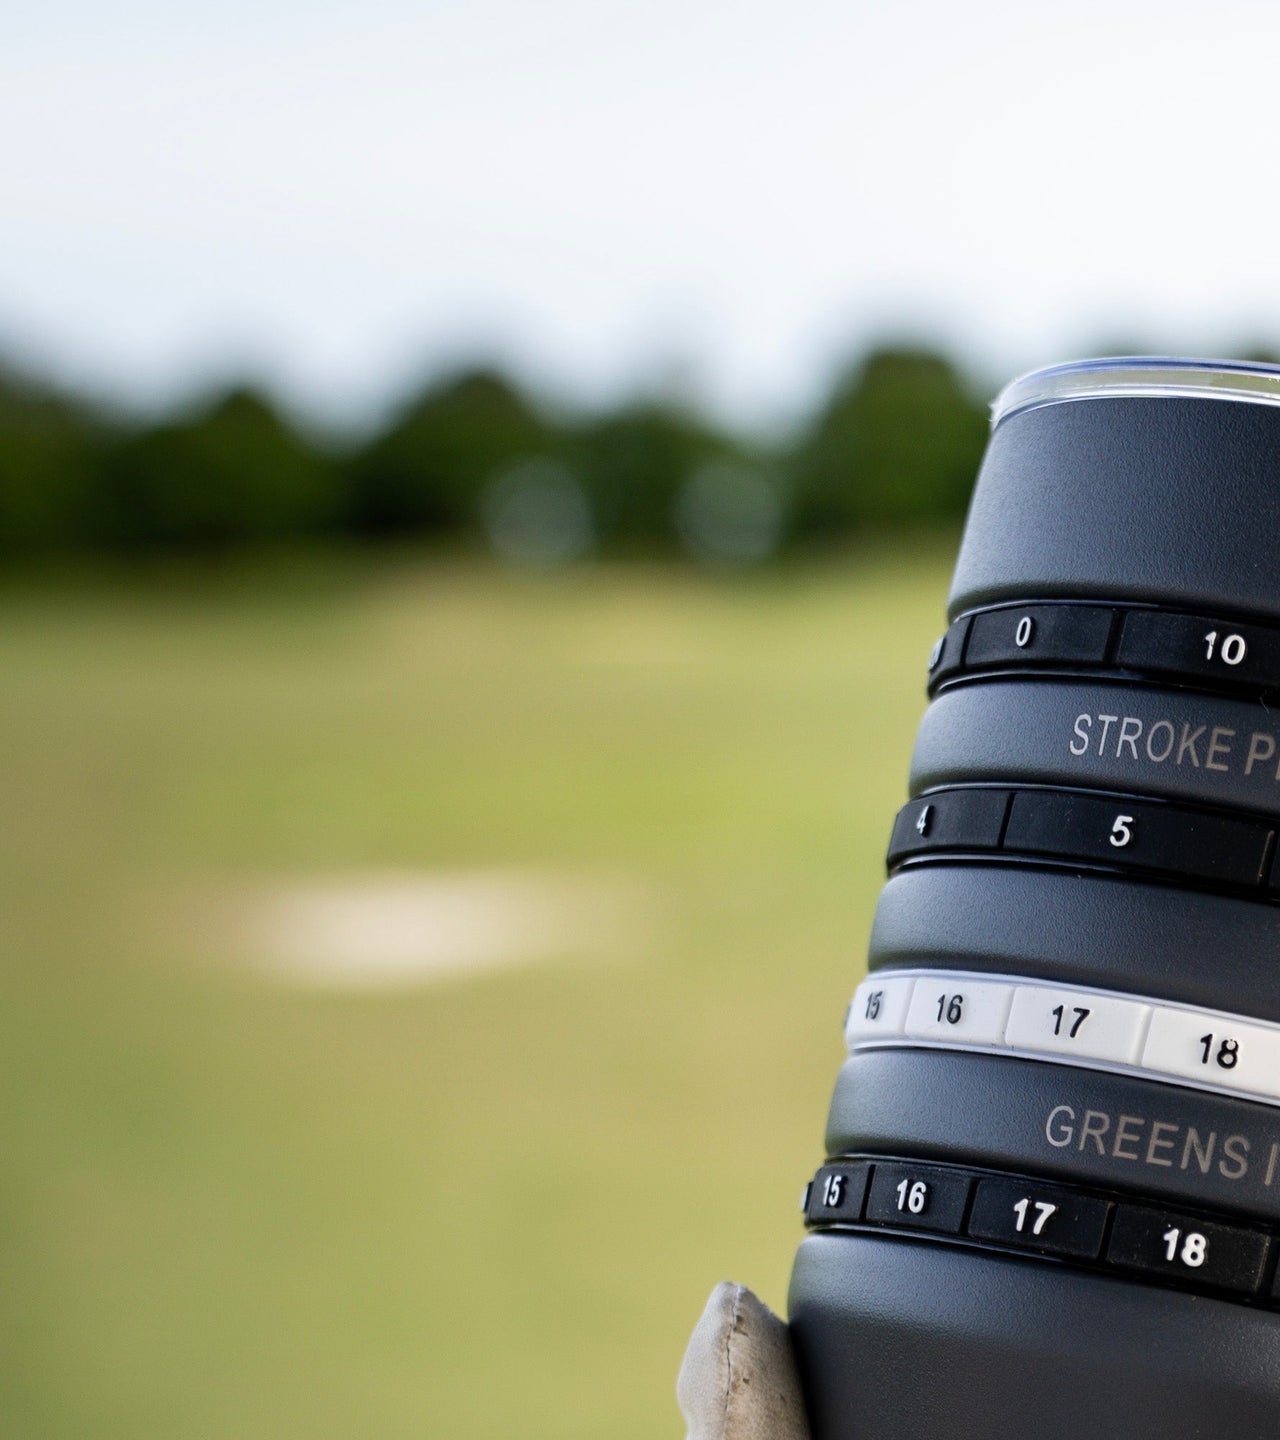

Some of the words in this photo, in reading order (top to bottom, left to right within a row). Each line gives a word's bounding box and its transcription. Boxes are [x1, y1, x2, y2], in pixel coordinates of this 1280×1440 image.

[1014, 616, 1033, 648] 0
[1204, 631, 1246, 665] 10
[1068, 713, 1237, 773] STROKE
[915, 804, 931, 835] 4
[1109, 815, 1134, 847] 5
[864, 992, 882, 1019] 15
[936, 994, 963, 1025] 16
[1051, 1005, 1090, 1038] 17
[1199, 1032, 1240, 1070] 18
[1046, 1105, 1251, 1179] GREENS
[822, 1174, 845, 1207] 15
[896, 1179, 926, 1213] 16
[1014, 1198, 1058, 1235] 17
[1163, 1227, 1208, 1268] 18
